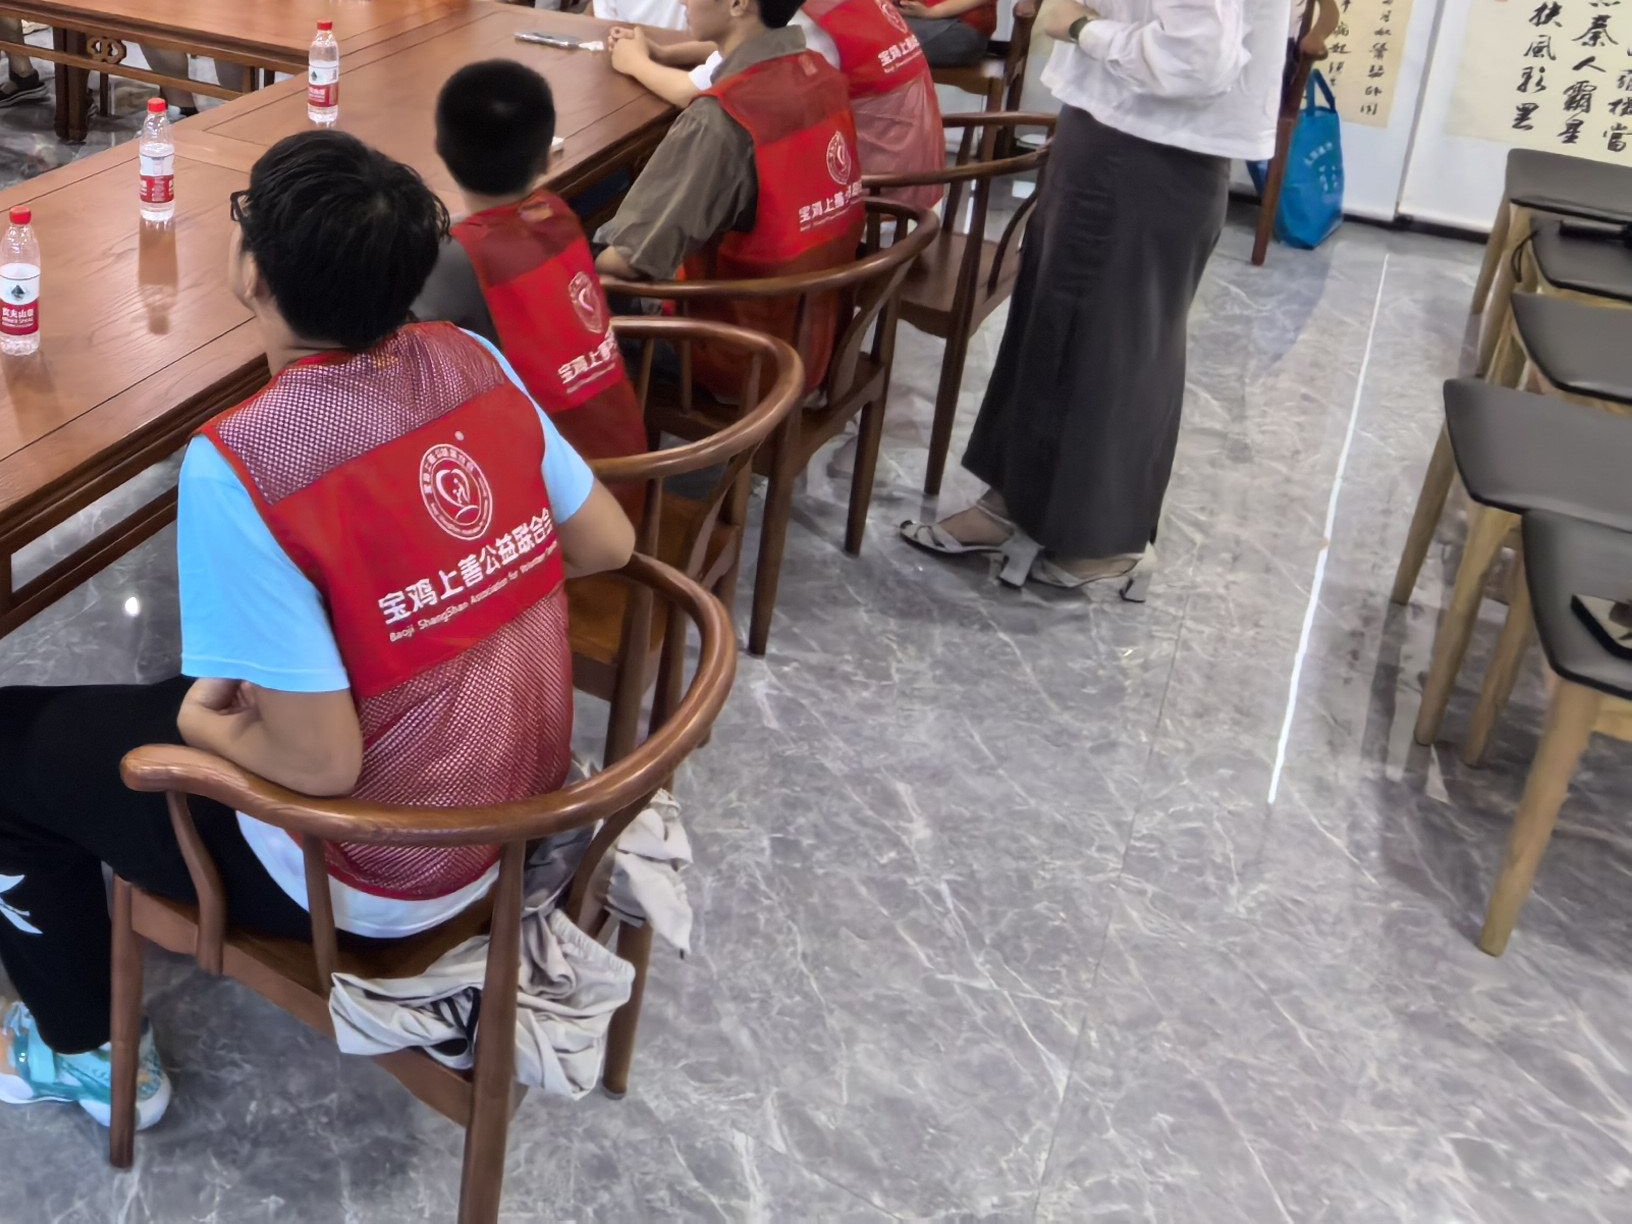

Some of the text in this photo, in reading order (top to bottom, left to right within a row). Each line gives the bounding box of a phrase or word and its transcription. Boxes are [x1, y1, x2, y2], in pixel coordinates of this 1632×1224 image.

[378, 507, 553, 625] 宝鸡上善公益联合会
